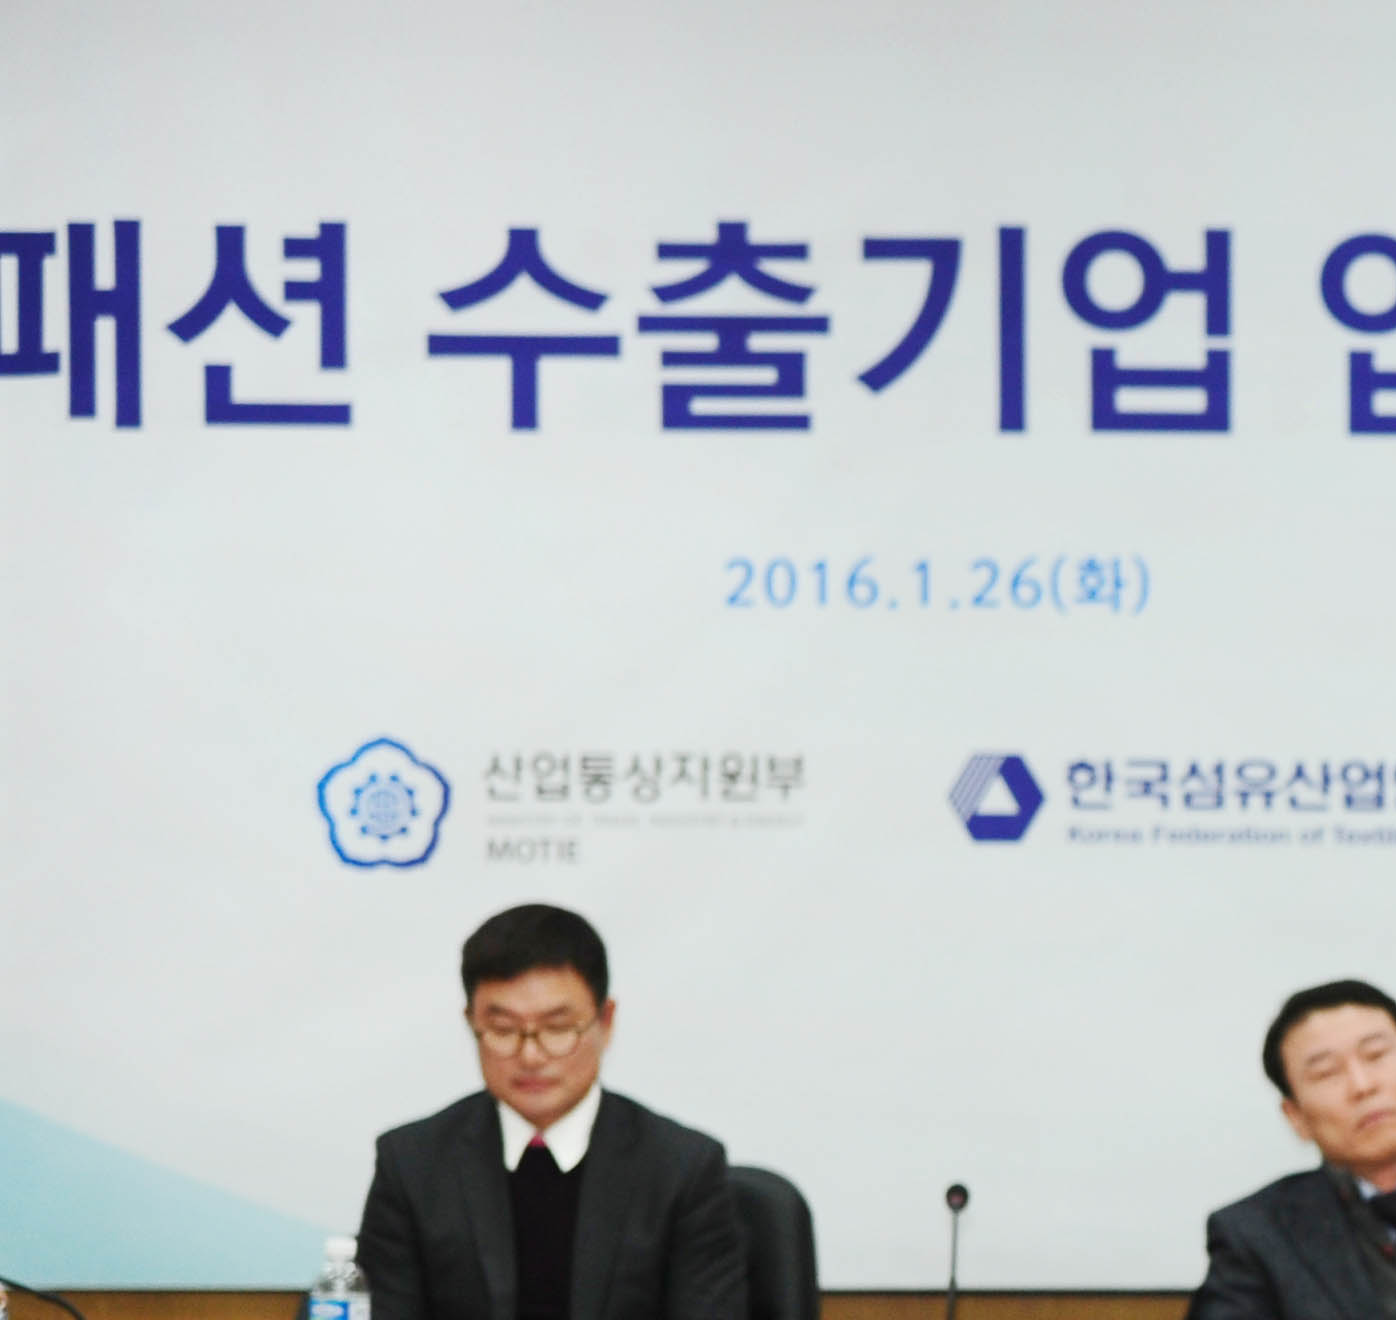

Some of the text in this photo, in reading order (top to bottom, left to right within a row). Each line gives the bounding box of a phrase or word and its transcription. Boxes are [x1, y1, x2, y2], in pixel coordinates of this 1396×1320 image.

[0, 218, 354, 431] 패션
[425, 220, 1235, 435] 수출기업
[723, 555, 1151, 614] 2016.1.26(화)
[484, 750, 806, 803] 산업통상자원부
[485, 837, 579, 864] MOTIE
[1066, 825, 1143, 844] Korea
[1152, 825, 1289, 844] Federation
[1299, 825, 1325, 844] of
